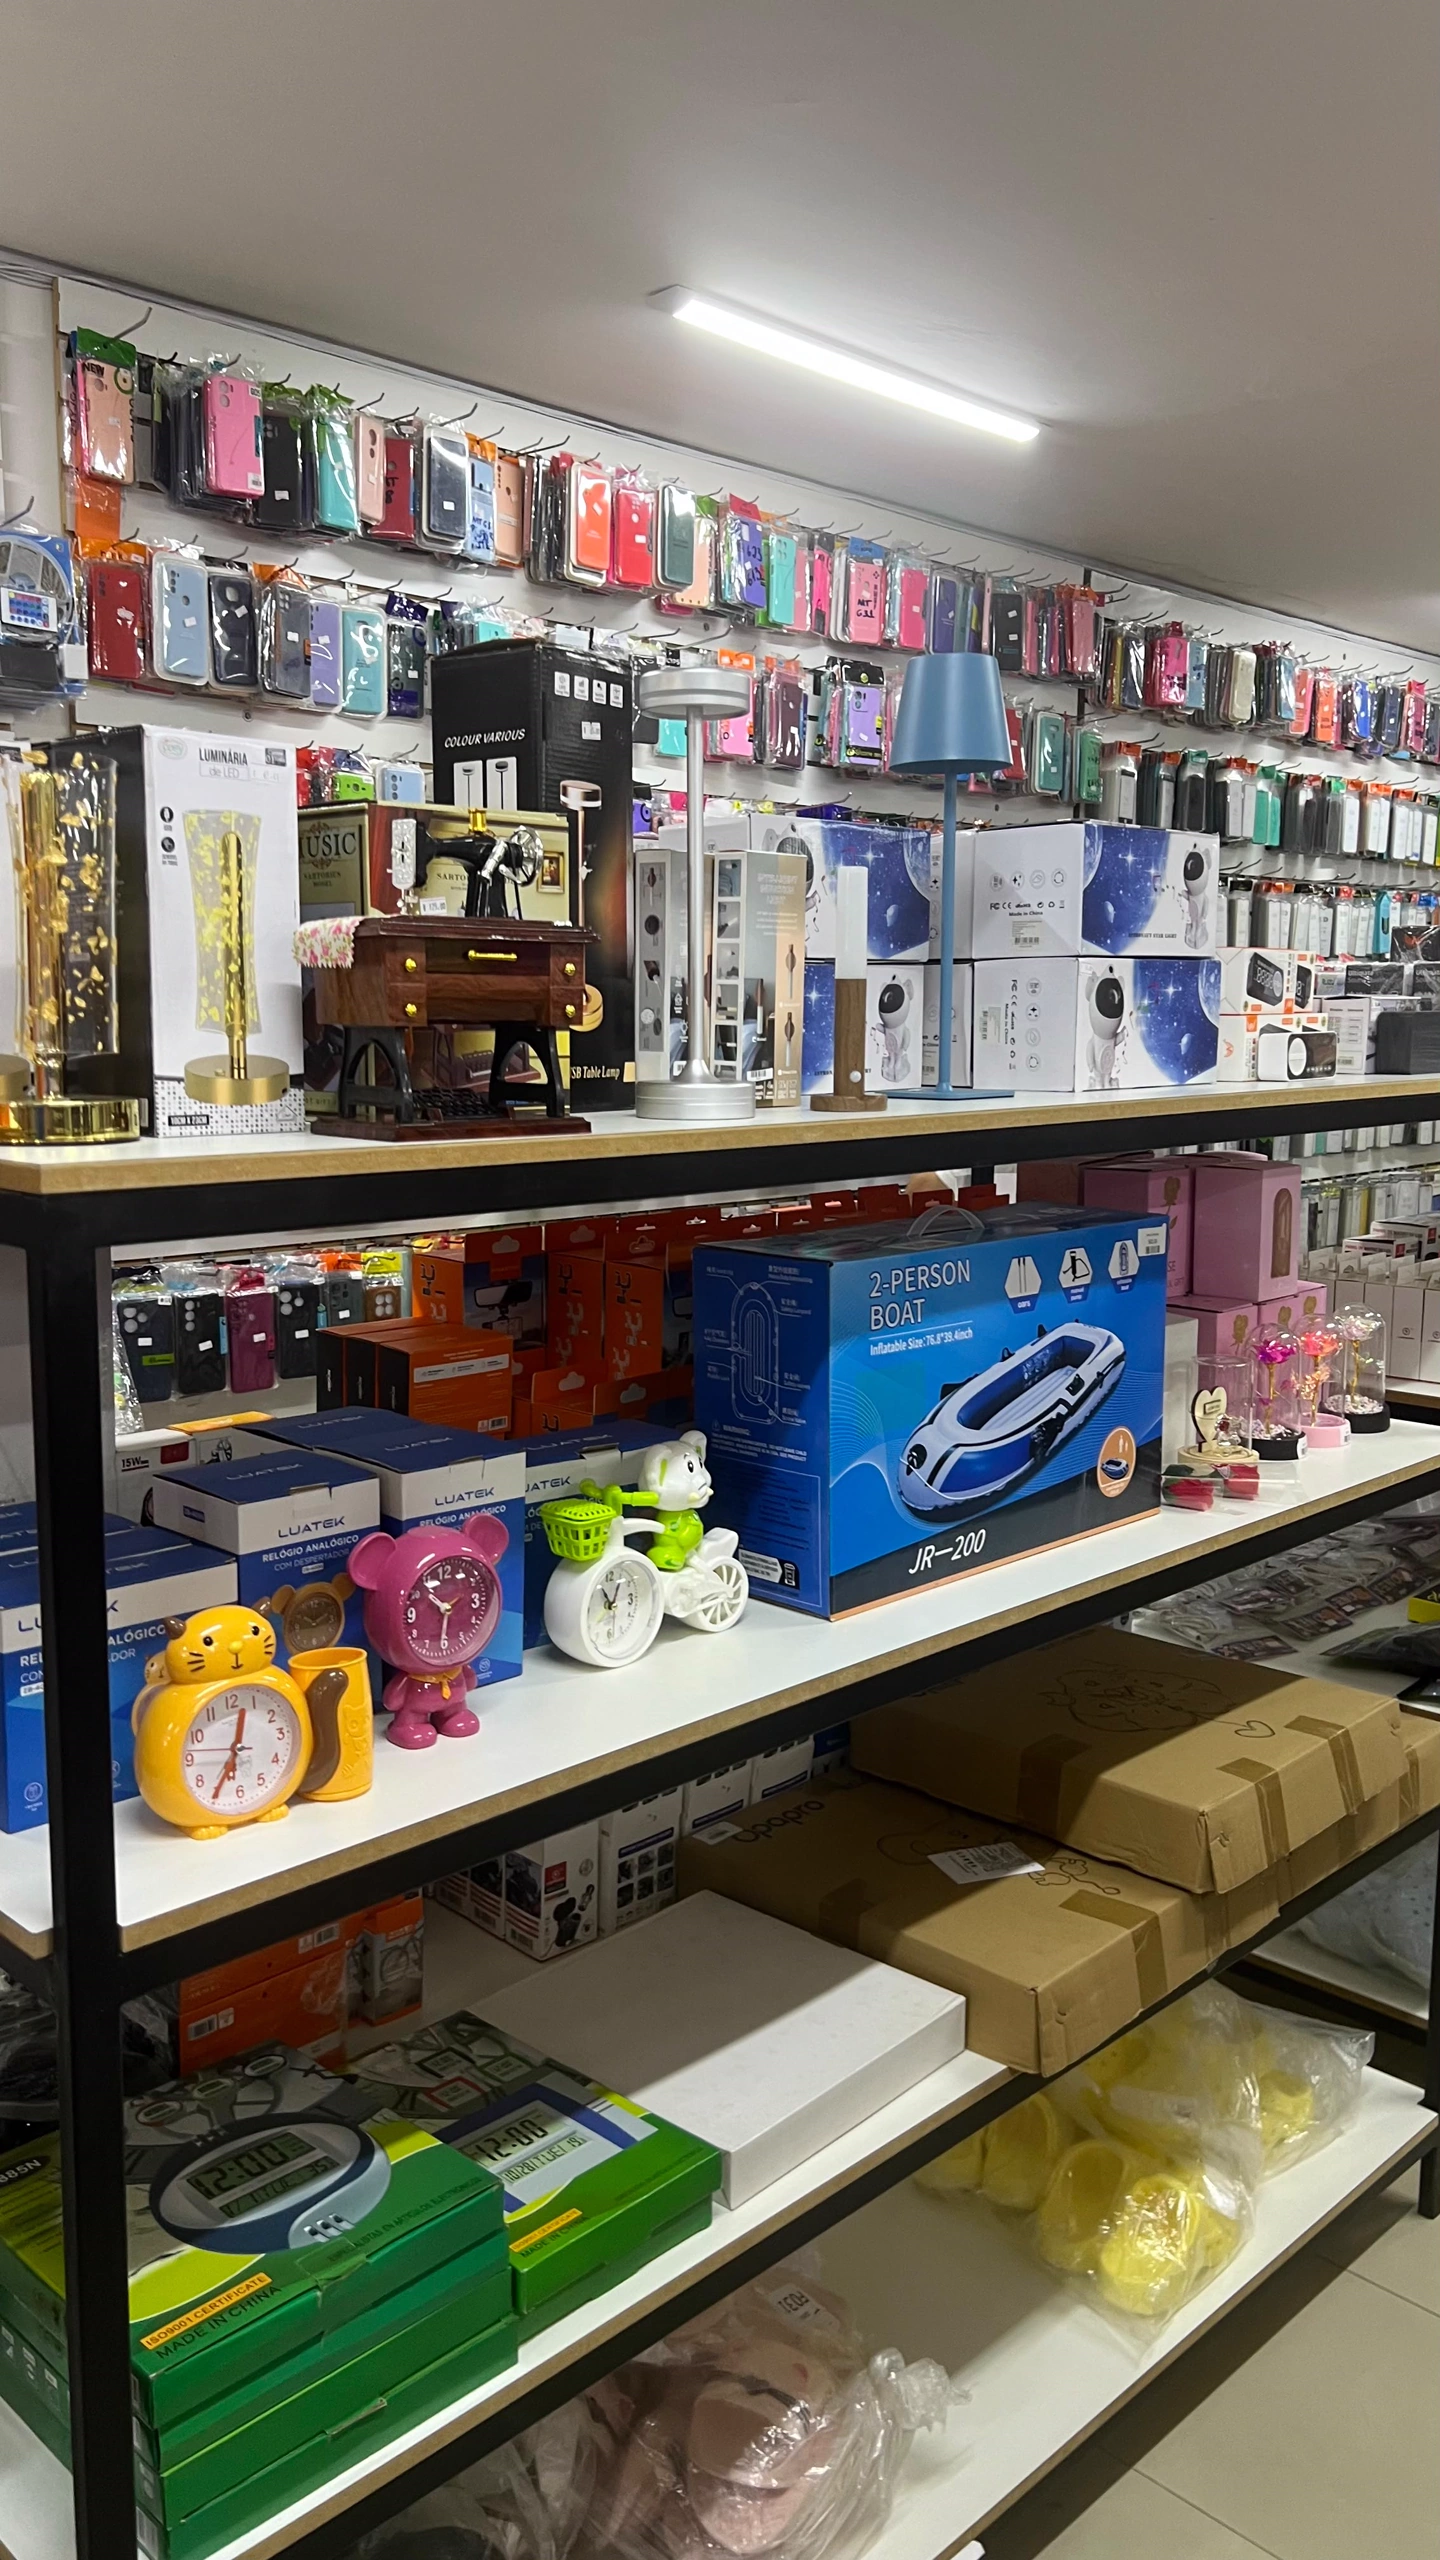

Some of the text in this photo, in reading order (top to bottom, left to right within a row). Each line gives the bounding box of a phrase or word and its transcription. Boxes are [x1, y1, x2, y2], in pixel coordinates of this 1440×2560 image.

[82, 362, 105, 377] NEW
[444, 728, 526, 749] COLOUR VARIOUS
[199, 747, 248, 766] LUMINÁRIA
[209, 766, 240, 779] de LED
[437, 873, 467, 882] SARTO
[571, 1065, 620, 1081] SB Table Lamp
[868, 1258, 971, 1298] 2-PERSON
[869, 1298, 926, 1332] BOAT
[869, 1337, 907, 1356] Inflatable
[298, 1415, 366, 1429] LUATEK
[385, 1437, 453, 1452] LUATEK
[121, 1458, 142, 1468] 15W
[226, 1462, 304, 1480] LUATEK
[435, 1486, 495, 1506] LUATEK
[278, 1515, 346, 1538] LUATEK
[262, 1534, 359, 1563] RELÓGIO ANALÓGICO
[274, 1560, 292, 1571] COM
[293, 1548, 349, 1568] DESPERTADOR
[437, 1565, 452, 1579] 12
[604, 1570, 615, 1583] 12
[471, 1593, 480, 1609] 3
[627, 1592, 634, 1606] 3
[407, 1607, 416, 1623] 9
[108, 1625, 167, 1647] ALÓGICO
[411, 1629, 418, 1638] 8
[424, 1640, 430, 1649] 7
[441, 1636, 448, 1649] 6
[225, 1694, 239, 1709] 12
[252, 1696, 256, 1709] 1
[206, 1706, 215, 1722] 11
[267, 1709, 276, 1723] 2
[190, 1728, 204, 1744] 10
[276, 1727, 285, 1740] 3
[185, 1753, 194, 1767] 9
[271, 1752, 280, 1765] 4
[195, 1774, 204, 1788] 8
[257, 1773, 266, 1786] 5
[236, 1785, 245, 1798] 6
[484, 2117, 550, 2162] 12:00
[520, 2216, 589, 2259] MADE IN CHINA
[144, 2273, 269, 2350] ISO9001 CERTIFICATE
[155, 2284, 282, 2360] MADE IN CHINA
